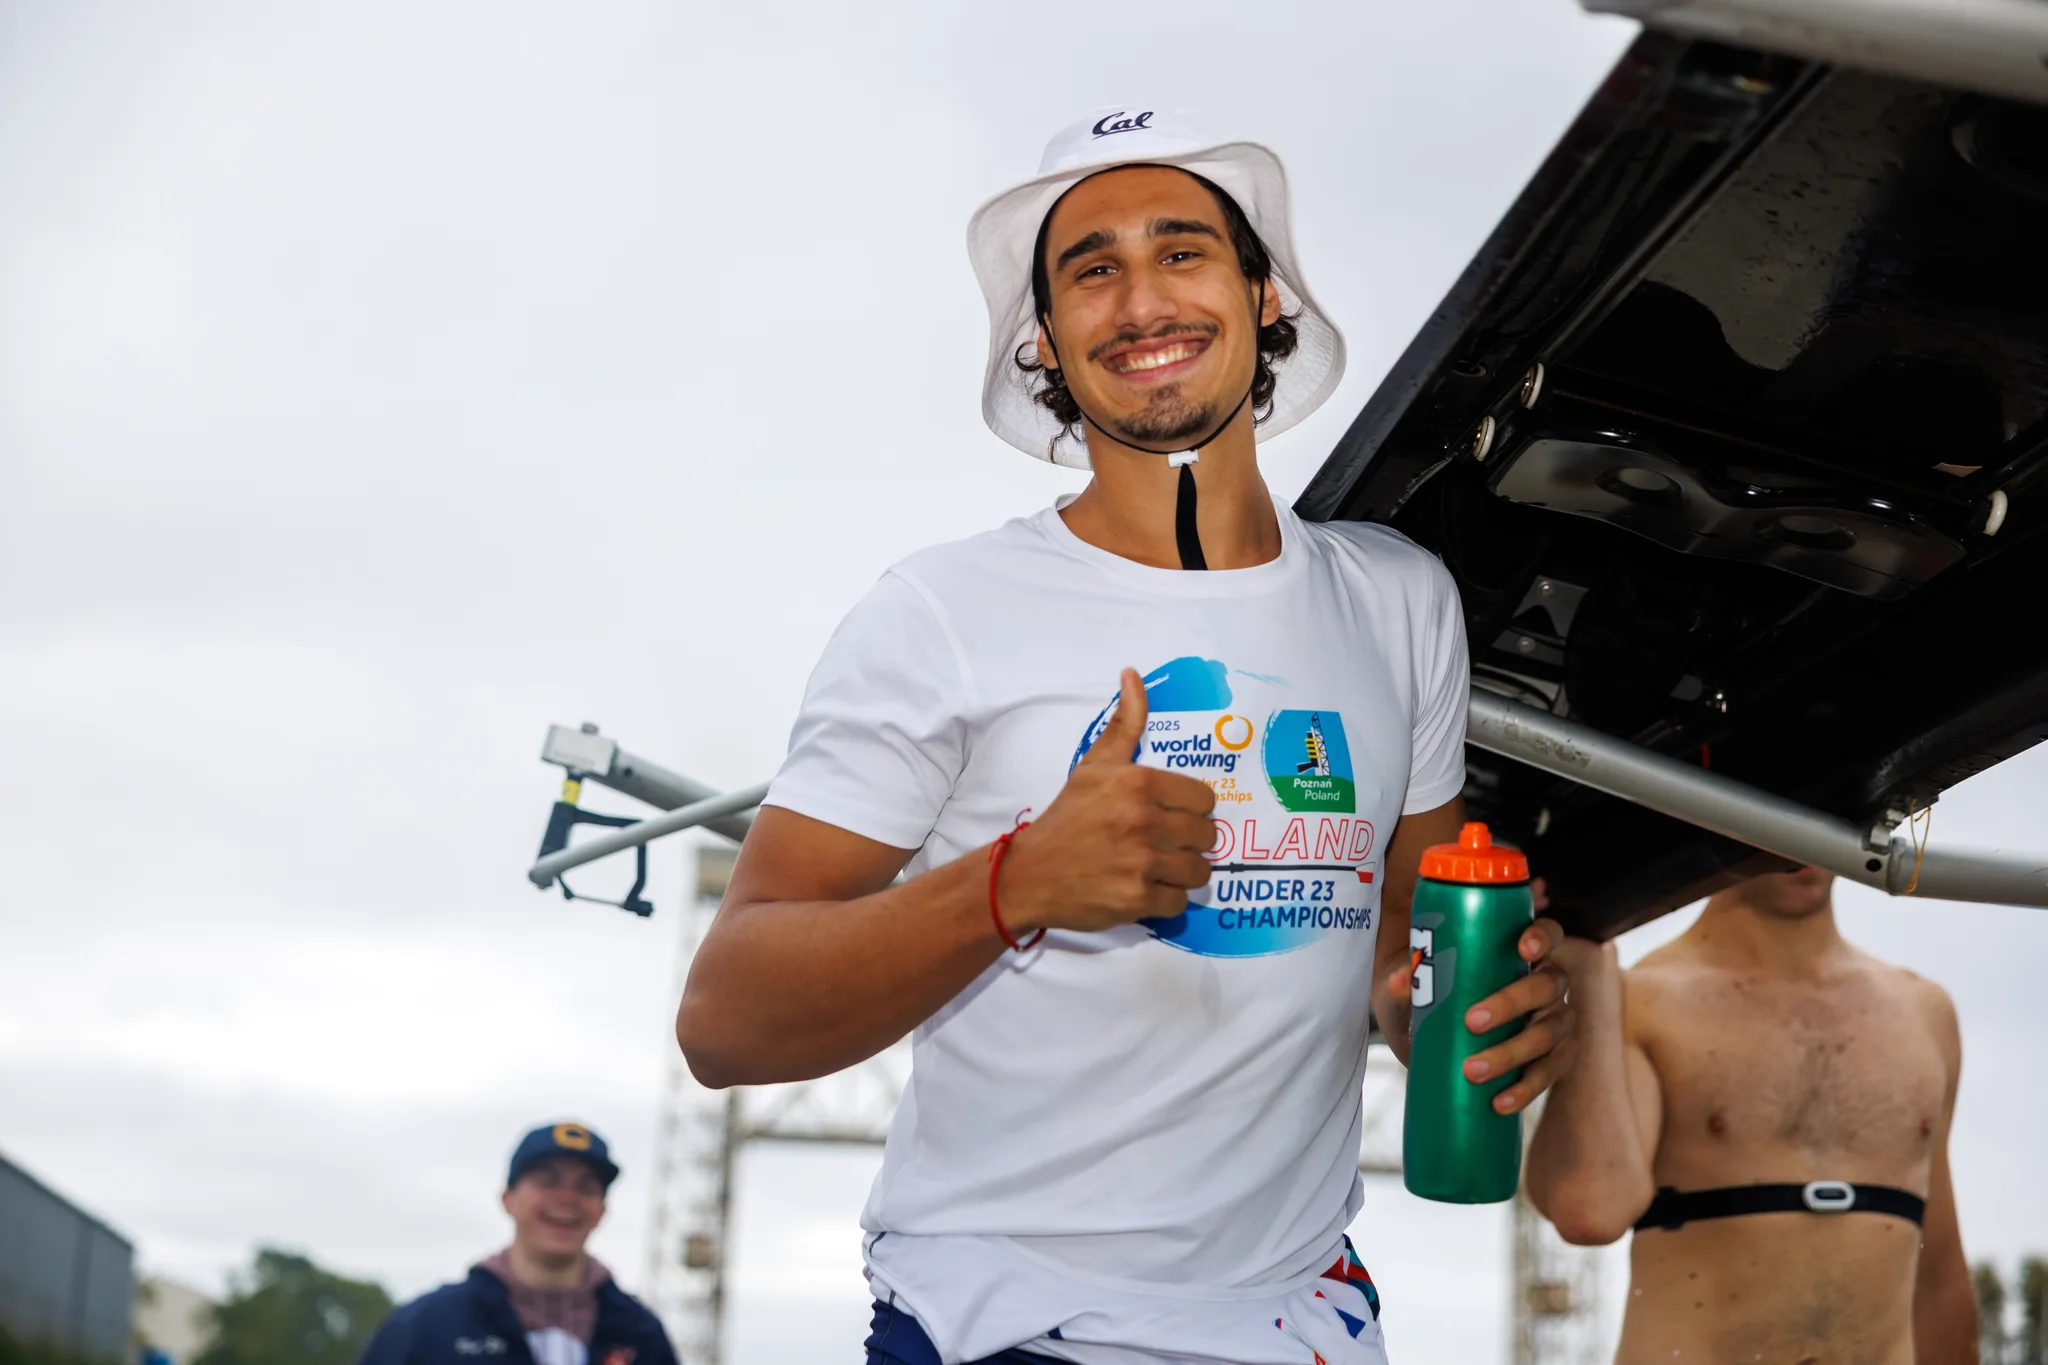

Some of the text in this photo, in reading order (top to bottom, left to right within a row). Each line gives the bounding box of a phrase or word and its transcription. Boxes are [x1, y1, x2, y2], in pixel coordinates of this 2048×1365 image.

[1092, 111, 1154, 140] Cal
[1148, 720, 1180, 731] 2025
[1151, 734, 1212, 752] world
[1166, 753, 1237, 773] rowing
[1220, 778, 1236, 789] 23
[1293, 777, 1332, 788] Poznań
[1304, 789, 1340, 801] Poland
[1201, 817, 1375, 862] OLAND
[1216, 879, 1335, 902] UNDER 23
[1217, 906, 1372, 930] CHAMPIONSHIPS
